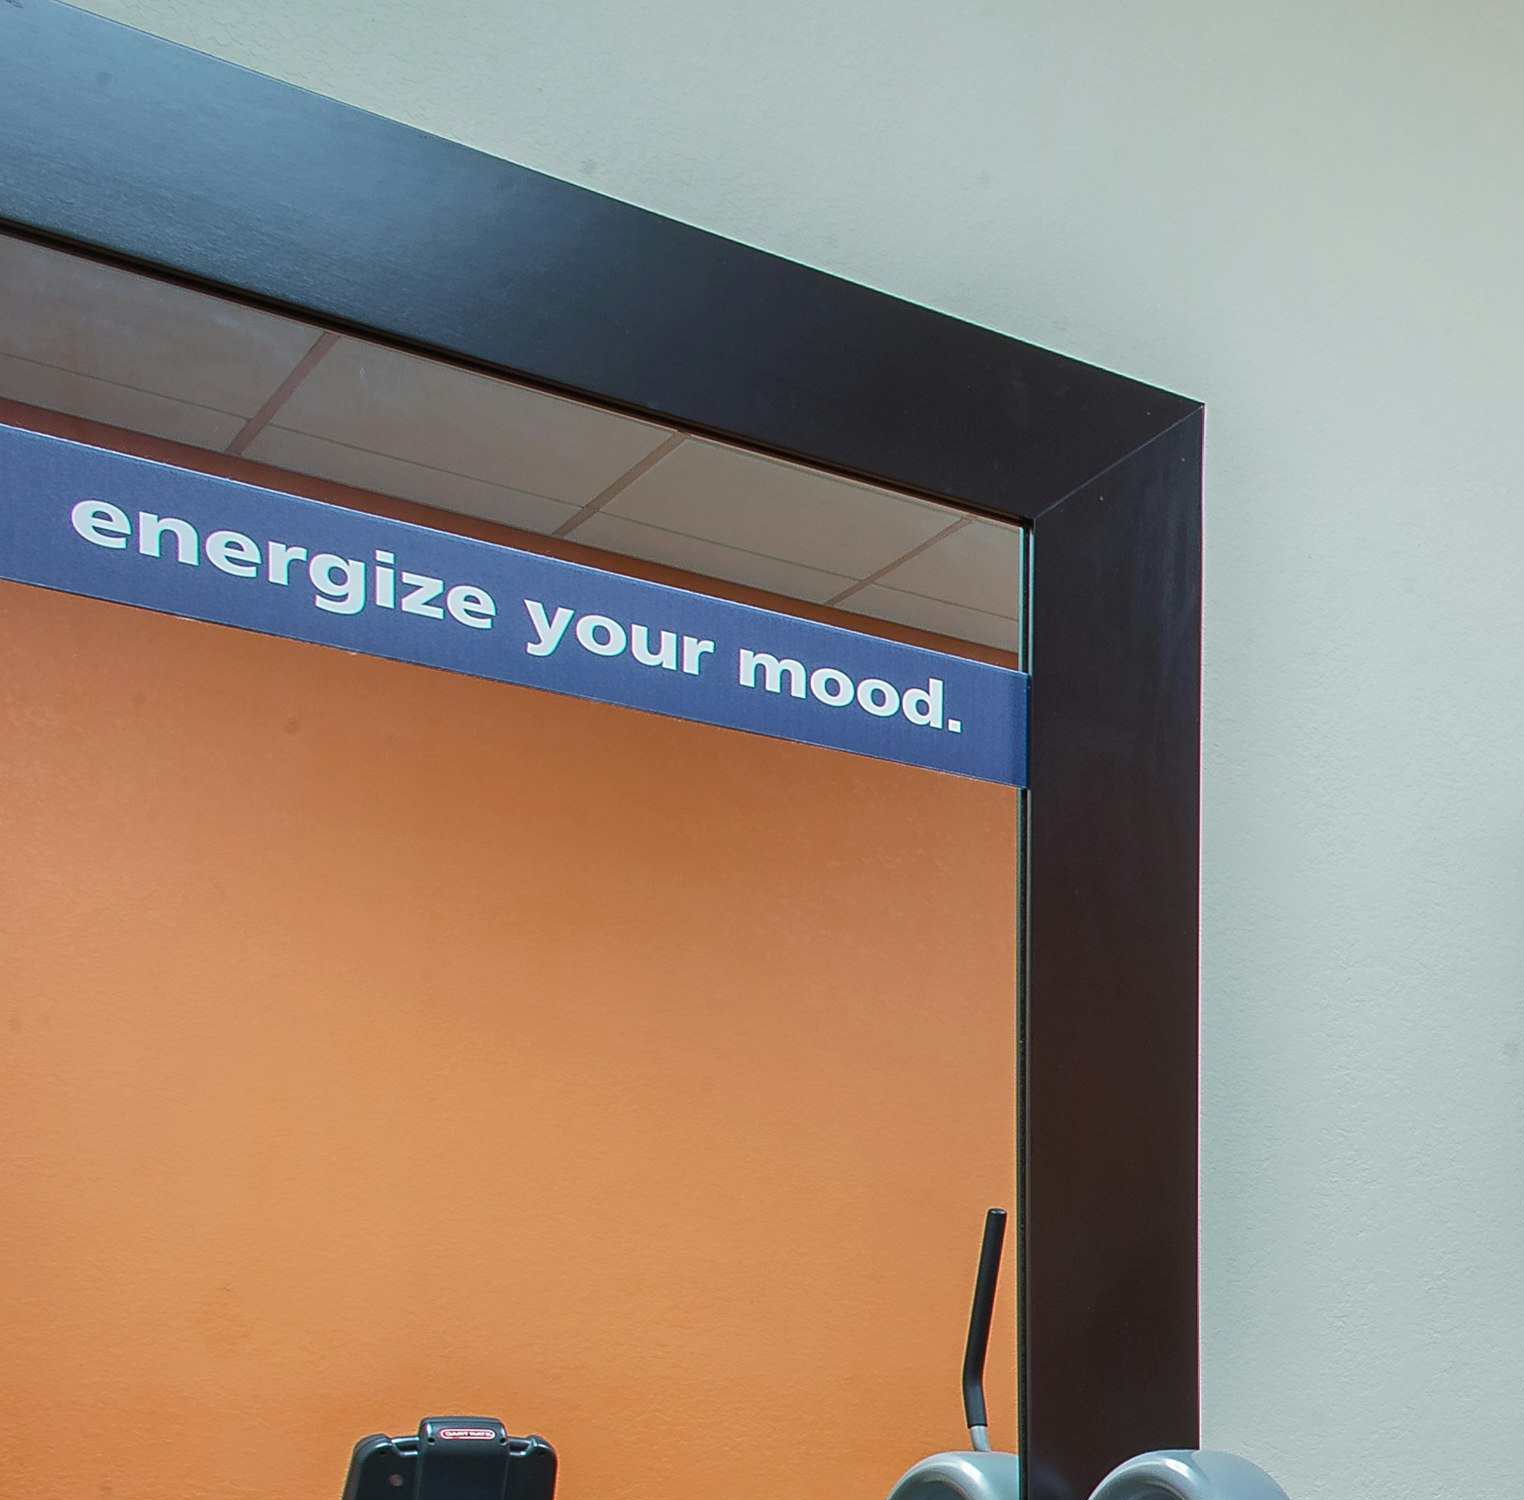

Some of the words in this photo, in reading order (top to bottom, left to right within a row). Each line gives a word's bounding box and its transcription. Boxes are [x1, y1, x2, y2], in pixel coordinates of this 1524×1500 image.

[69, 496, 498, 630] energize
[523, 599, 716, 676] your
[737, 645, 964, 733] mood.
